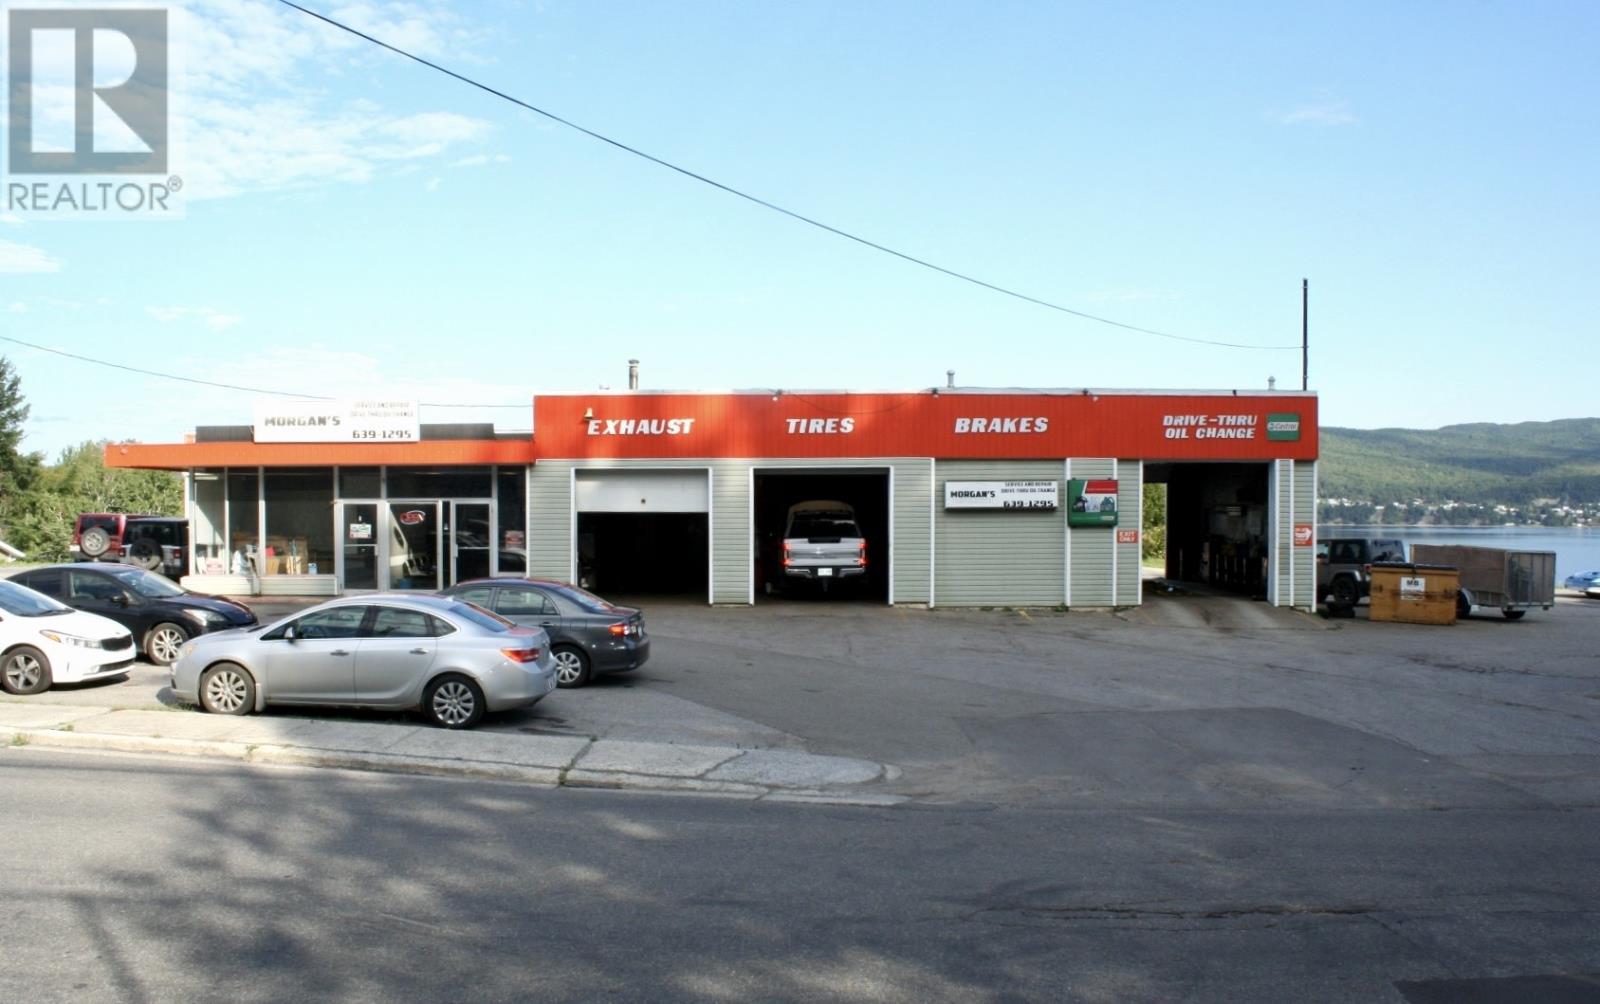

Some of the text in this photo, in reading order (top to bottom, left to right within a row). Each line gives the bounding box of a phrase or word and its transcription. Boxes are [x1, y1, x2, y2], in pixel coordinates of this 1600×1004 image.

[264, 415, 341, 427] MORGAN'S
[785, 417, 855, 434] TIRES
[954, 416, 1049, 434] BRAKES
[1162, 414, 1258, 426] DRIVE-THRU
[587, 418, 695, 436] EXHAUST
[1164, 427, 1256, 439] OIL CHANGE
[352, 429, 412, 439] 639-1295
[950, 490, 996, 498] MORGAN'S
[1003, 500, 1054, 508] 639-1295
